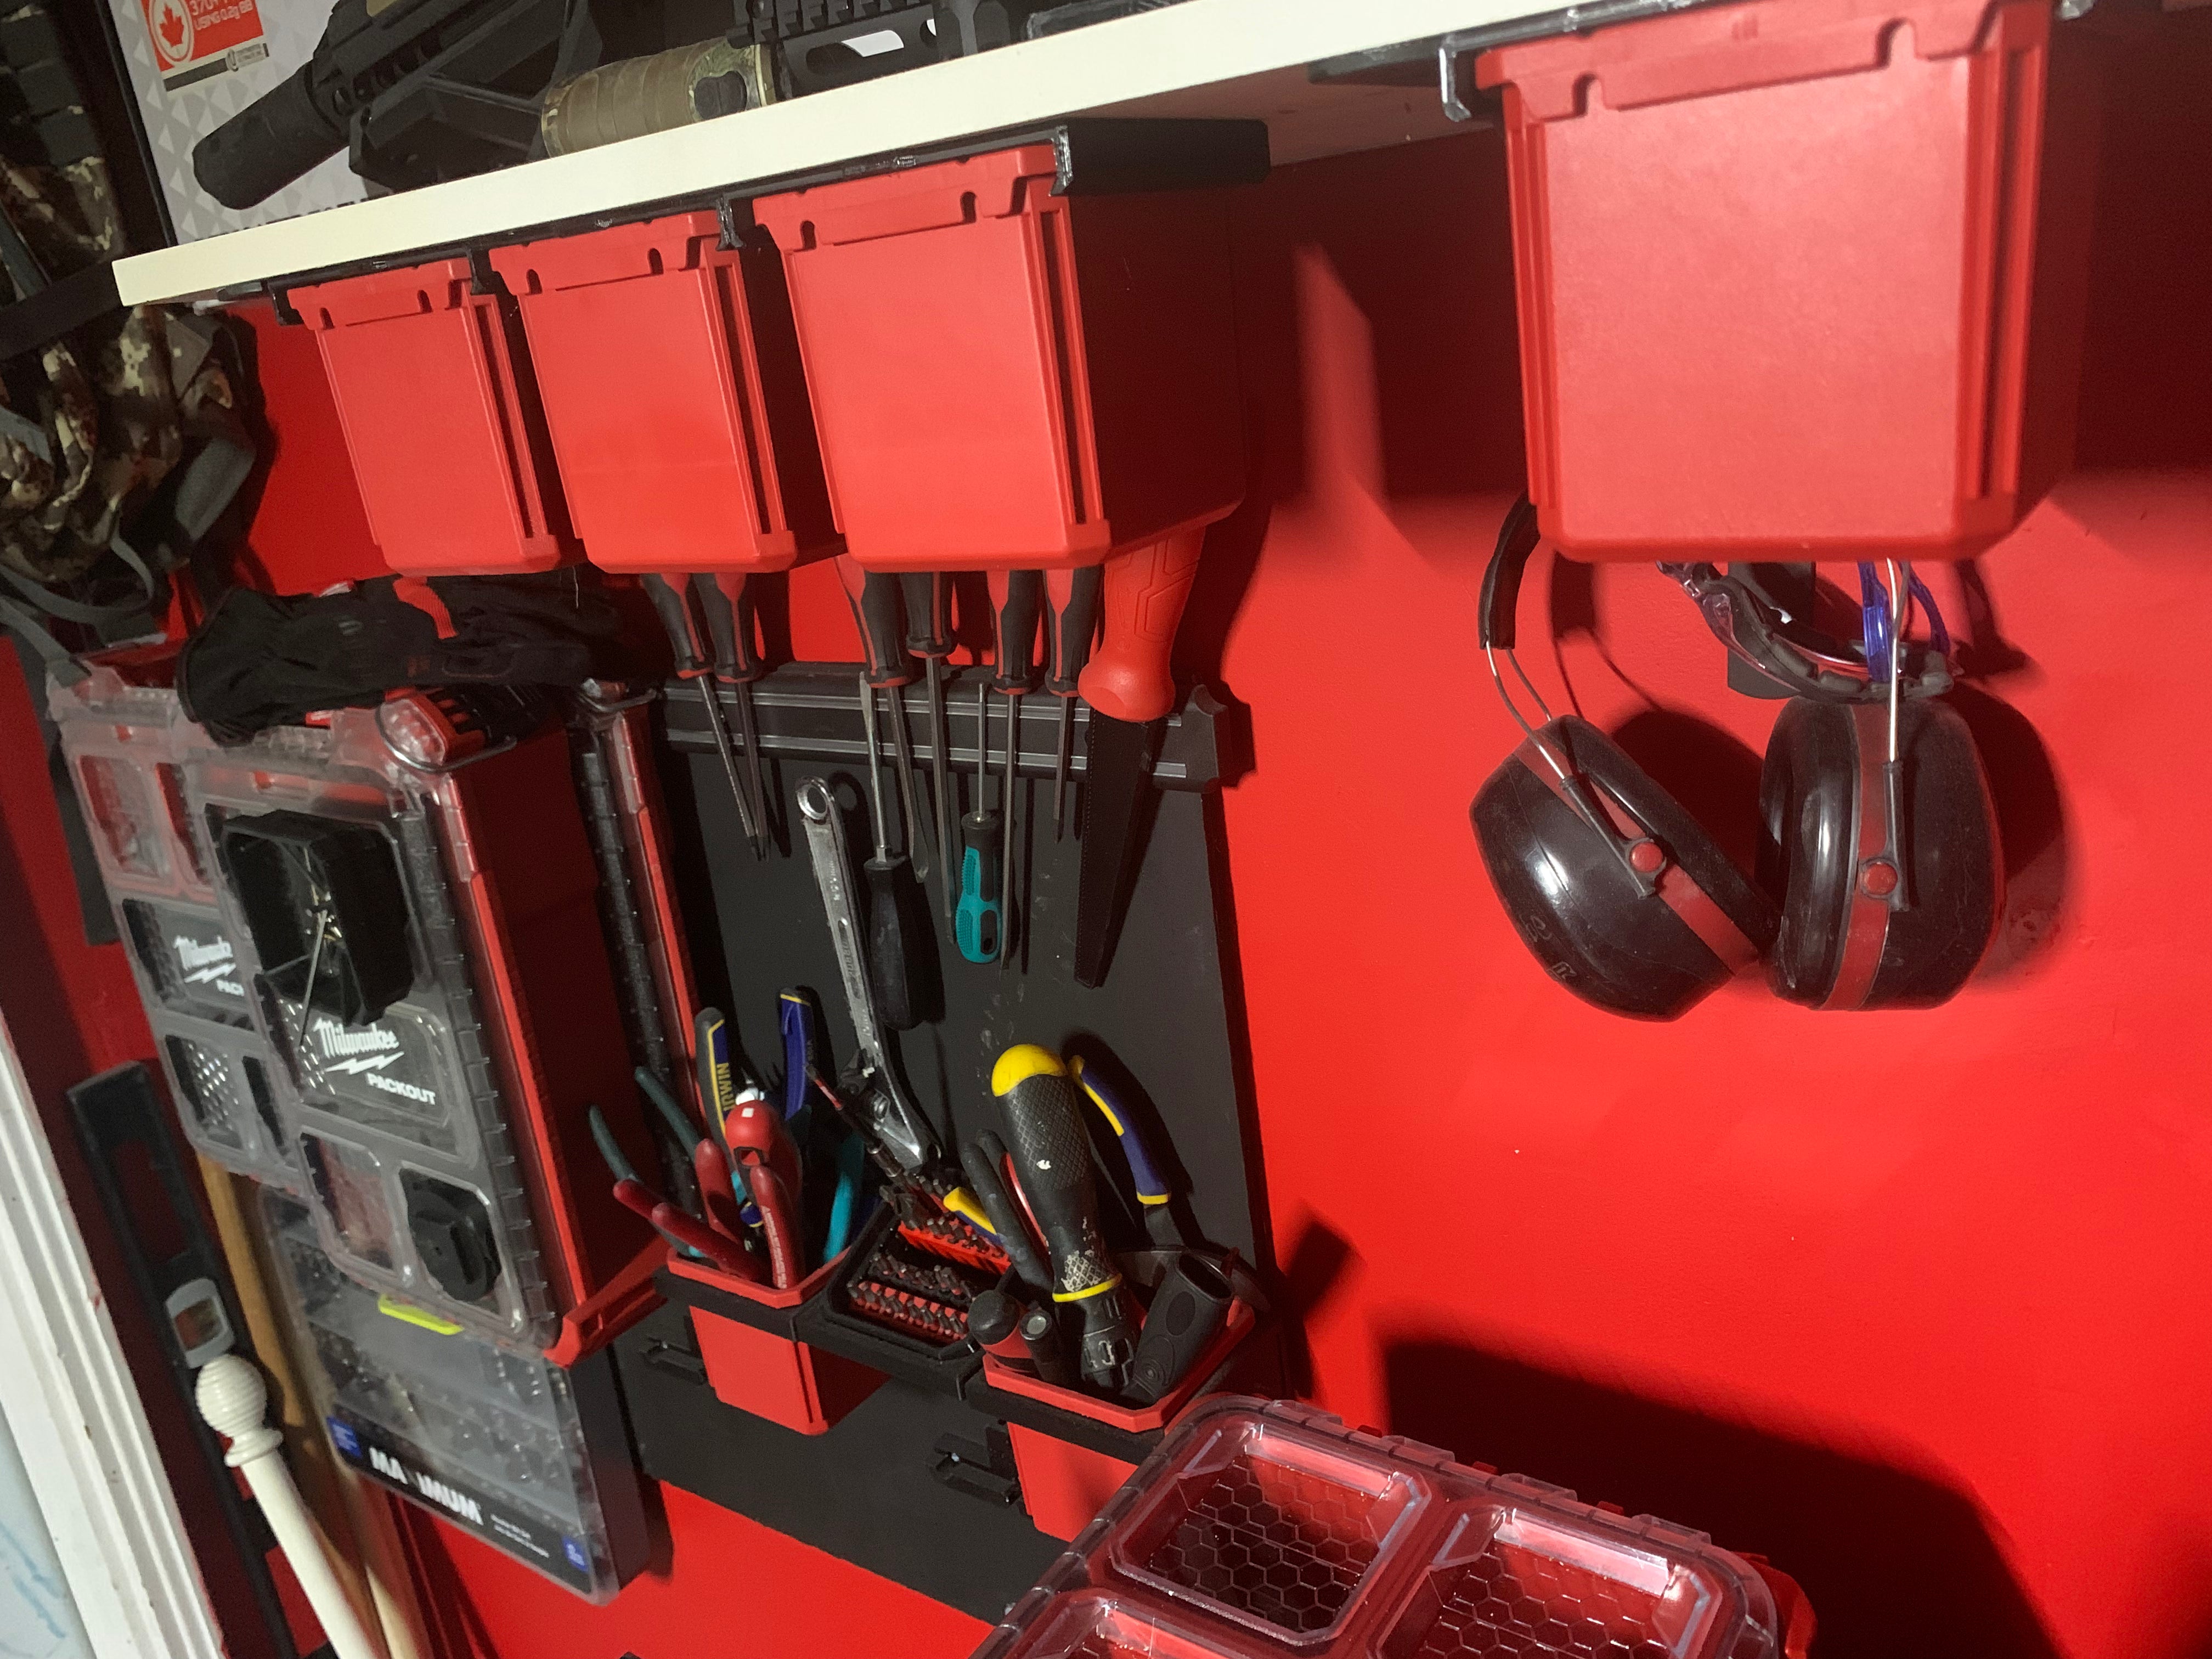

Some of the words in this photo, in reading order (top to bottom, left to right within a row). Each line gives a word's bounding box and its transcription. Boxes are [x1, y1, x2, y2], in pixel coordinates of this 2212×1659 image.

[313, 1017, 399, 1059] Milwaukee
[366, 1071, 436, 1105] PACKOUT
[716, 1062, 736, 1111] IRWIN
